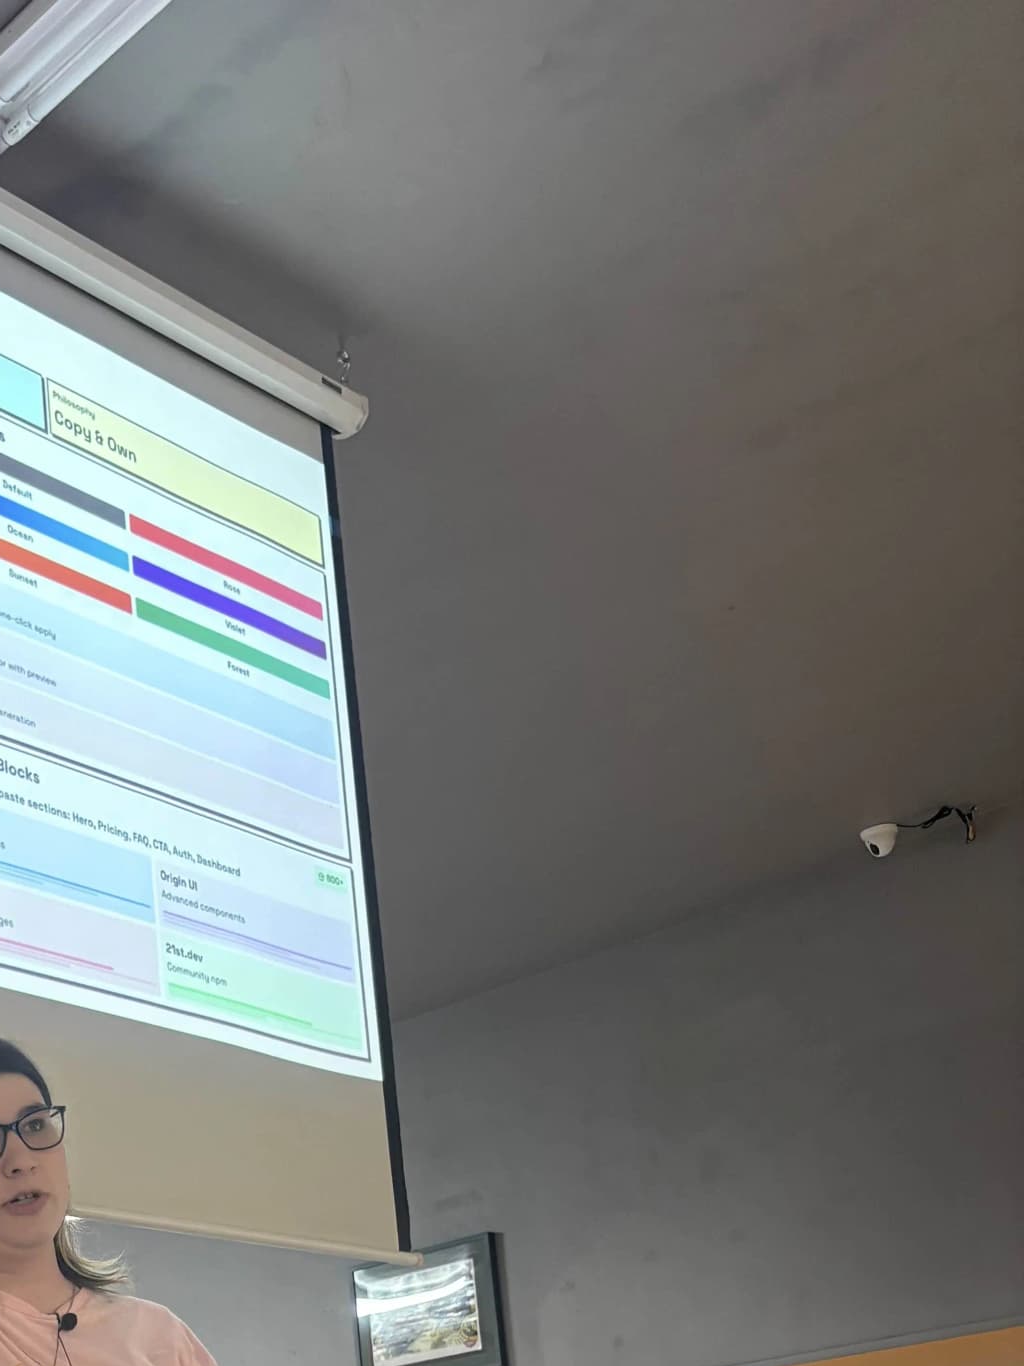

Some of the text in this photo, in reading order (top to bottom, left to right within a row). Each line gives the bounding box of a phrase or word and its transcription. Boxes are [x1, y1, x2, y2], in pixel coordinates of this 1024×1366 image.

[54, 409, 137, 464] Copy & Own
[2, 479, 33, 501] Default
[7, 524, 34, 543] Ocean
[196, 854, 241, 877] Dashboard
[160, 869, 198, 892] Origin UI
[165, 942, 203, 963] 21st.dev
